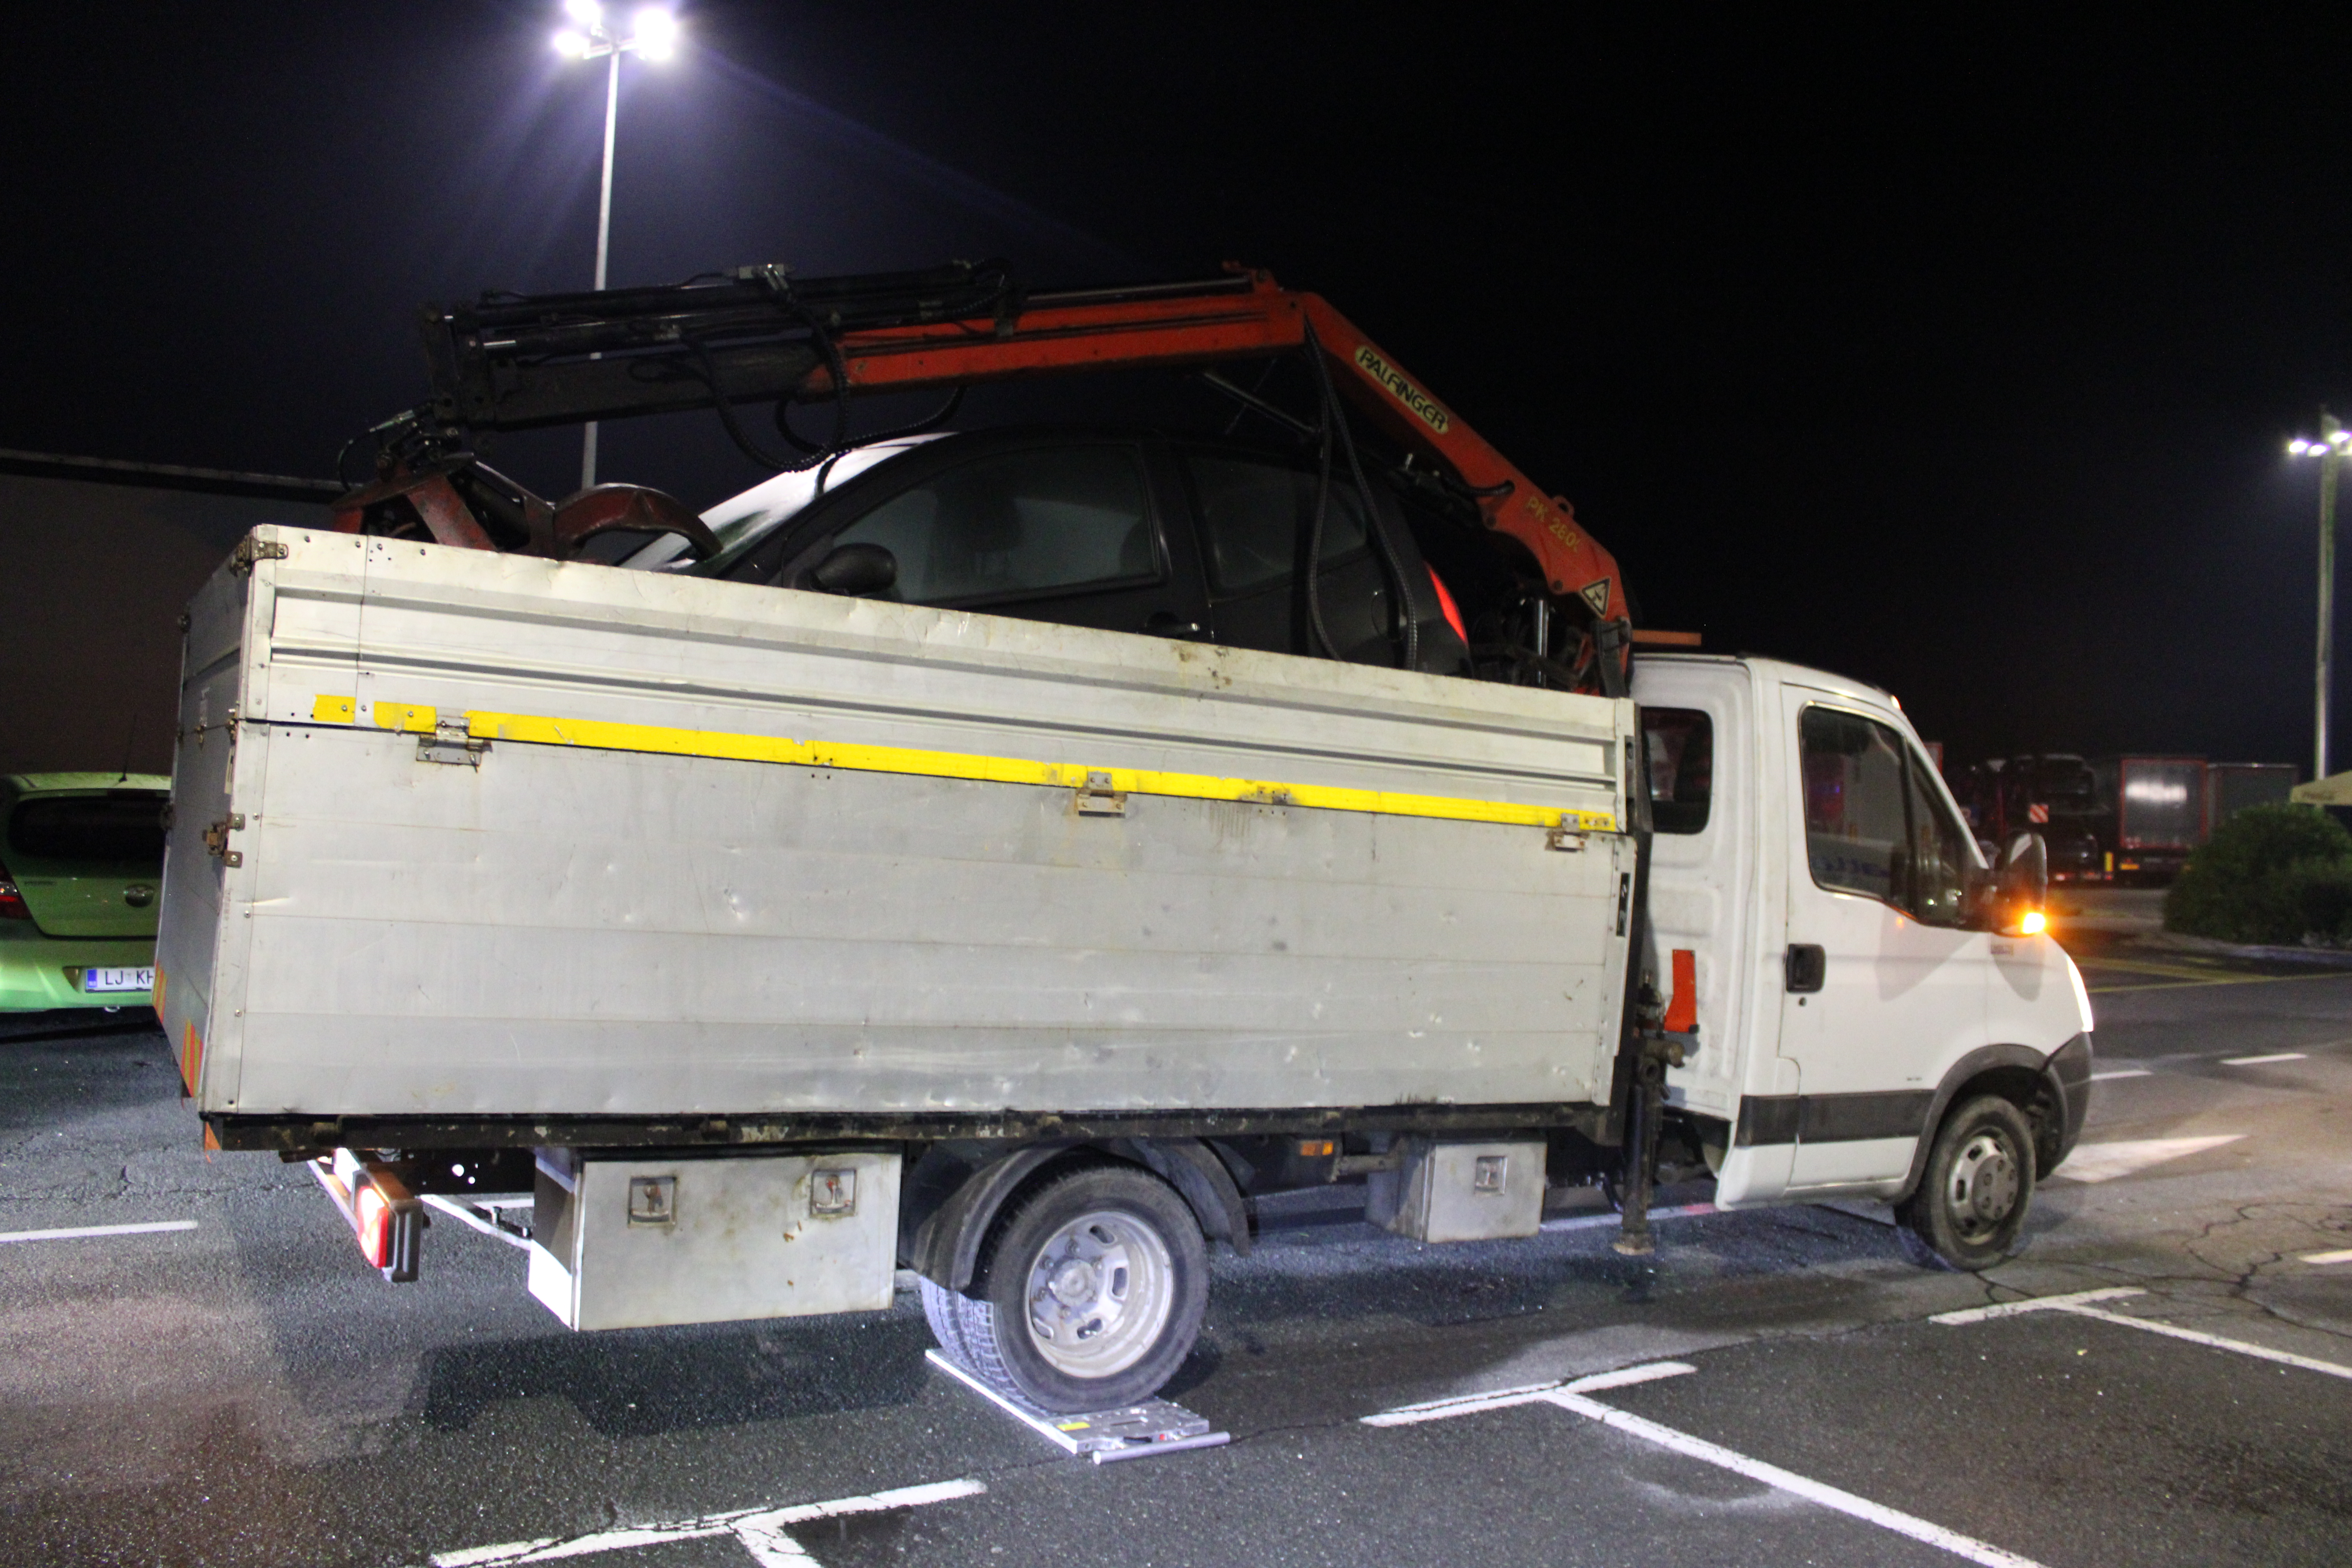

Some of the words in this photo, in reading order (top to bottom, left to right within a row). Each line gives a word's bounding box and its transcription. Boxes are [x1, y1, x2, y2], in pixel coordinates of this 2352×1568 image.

[1359, 349, 1447, 430] PALFINGER
[1525, 495, 1549, 522] PK
[105, 970, 124, 985] LJ
